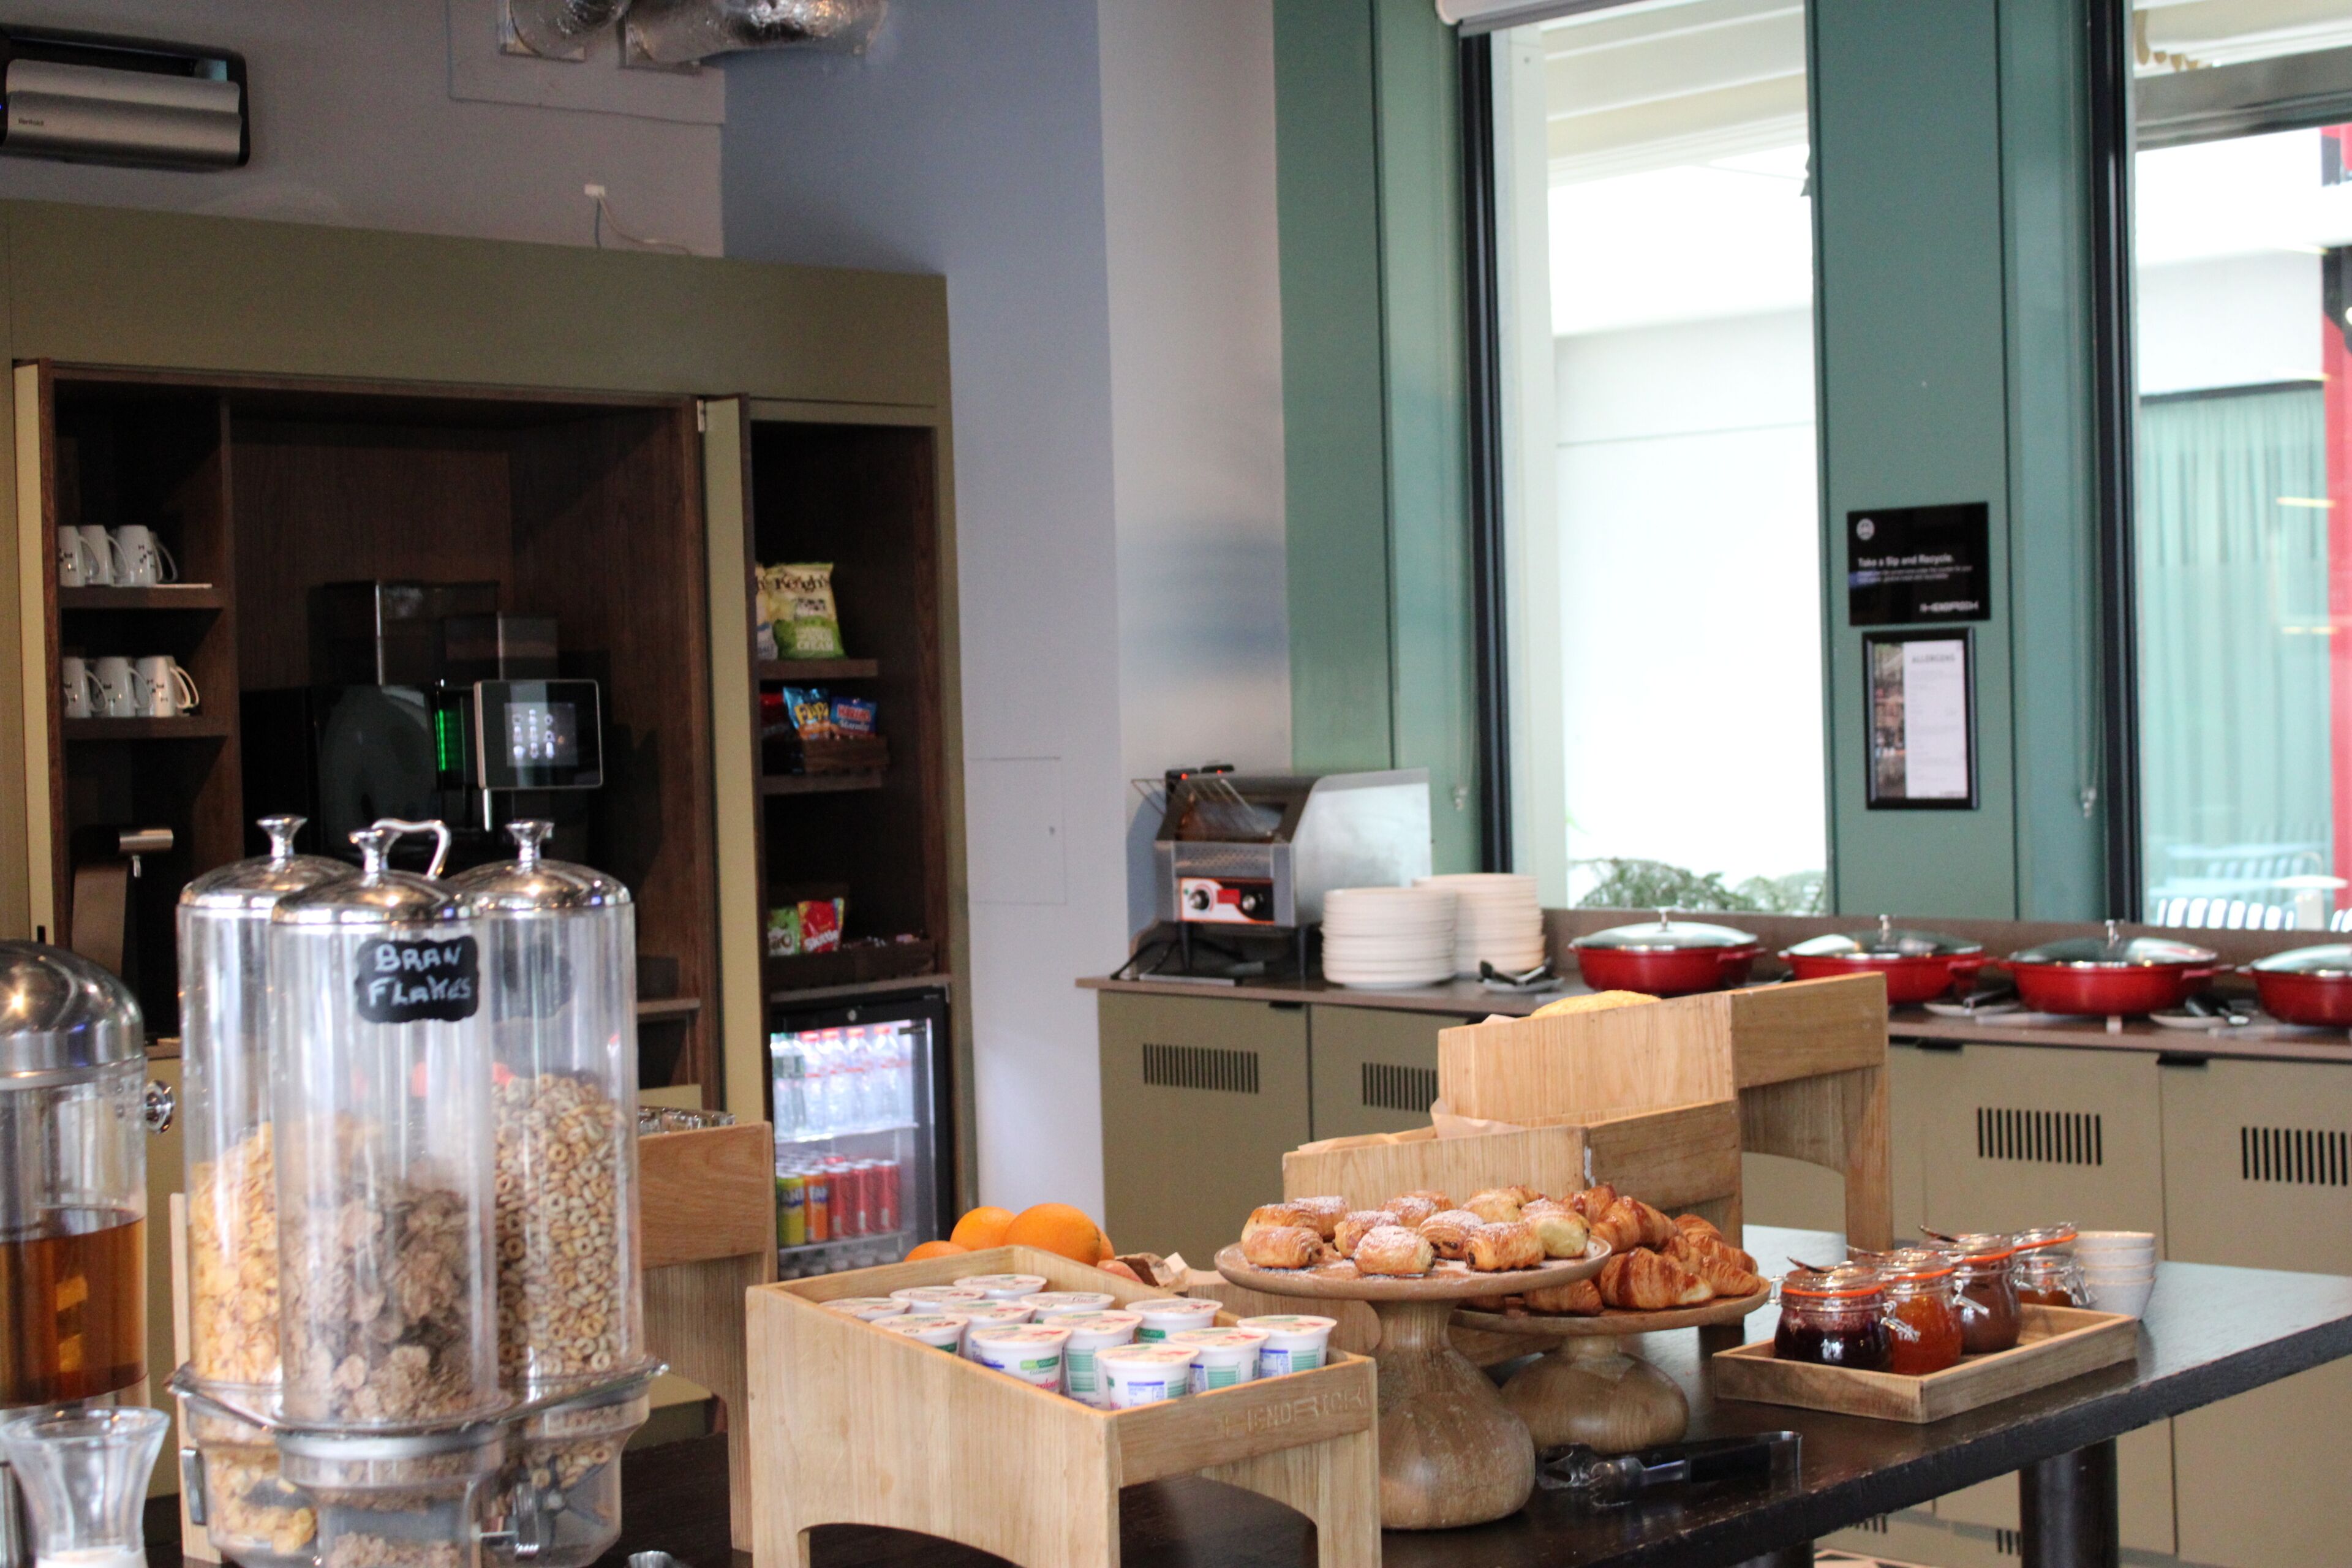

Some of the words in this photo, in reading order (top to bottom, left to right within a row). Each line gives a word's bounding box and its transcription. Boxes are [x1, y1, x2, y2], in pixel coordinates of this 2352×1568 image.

[1858, 557, 1877, 567] Take
[1885, 556, 1899, 566] Sip
[1901, 555, 1917, 565] and
[375, 943, 462, 973] BRAN
